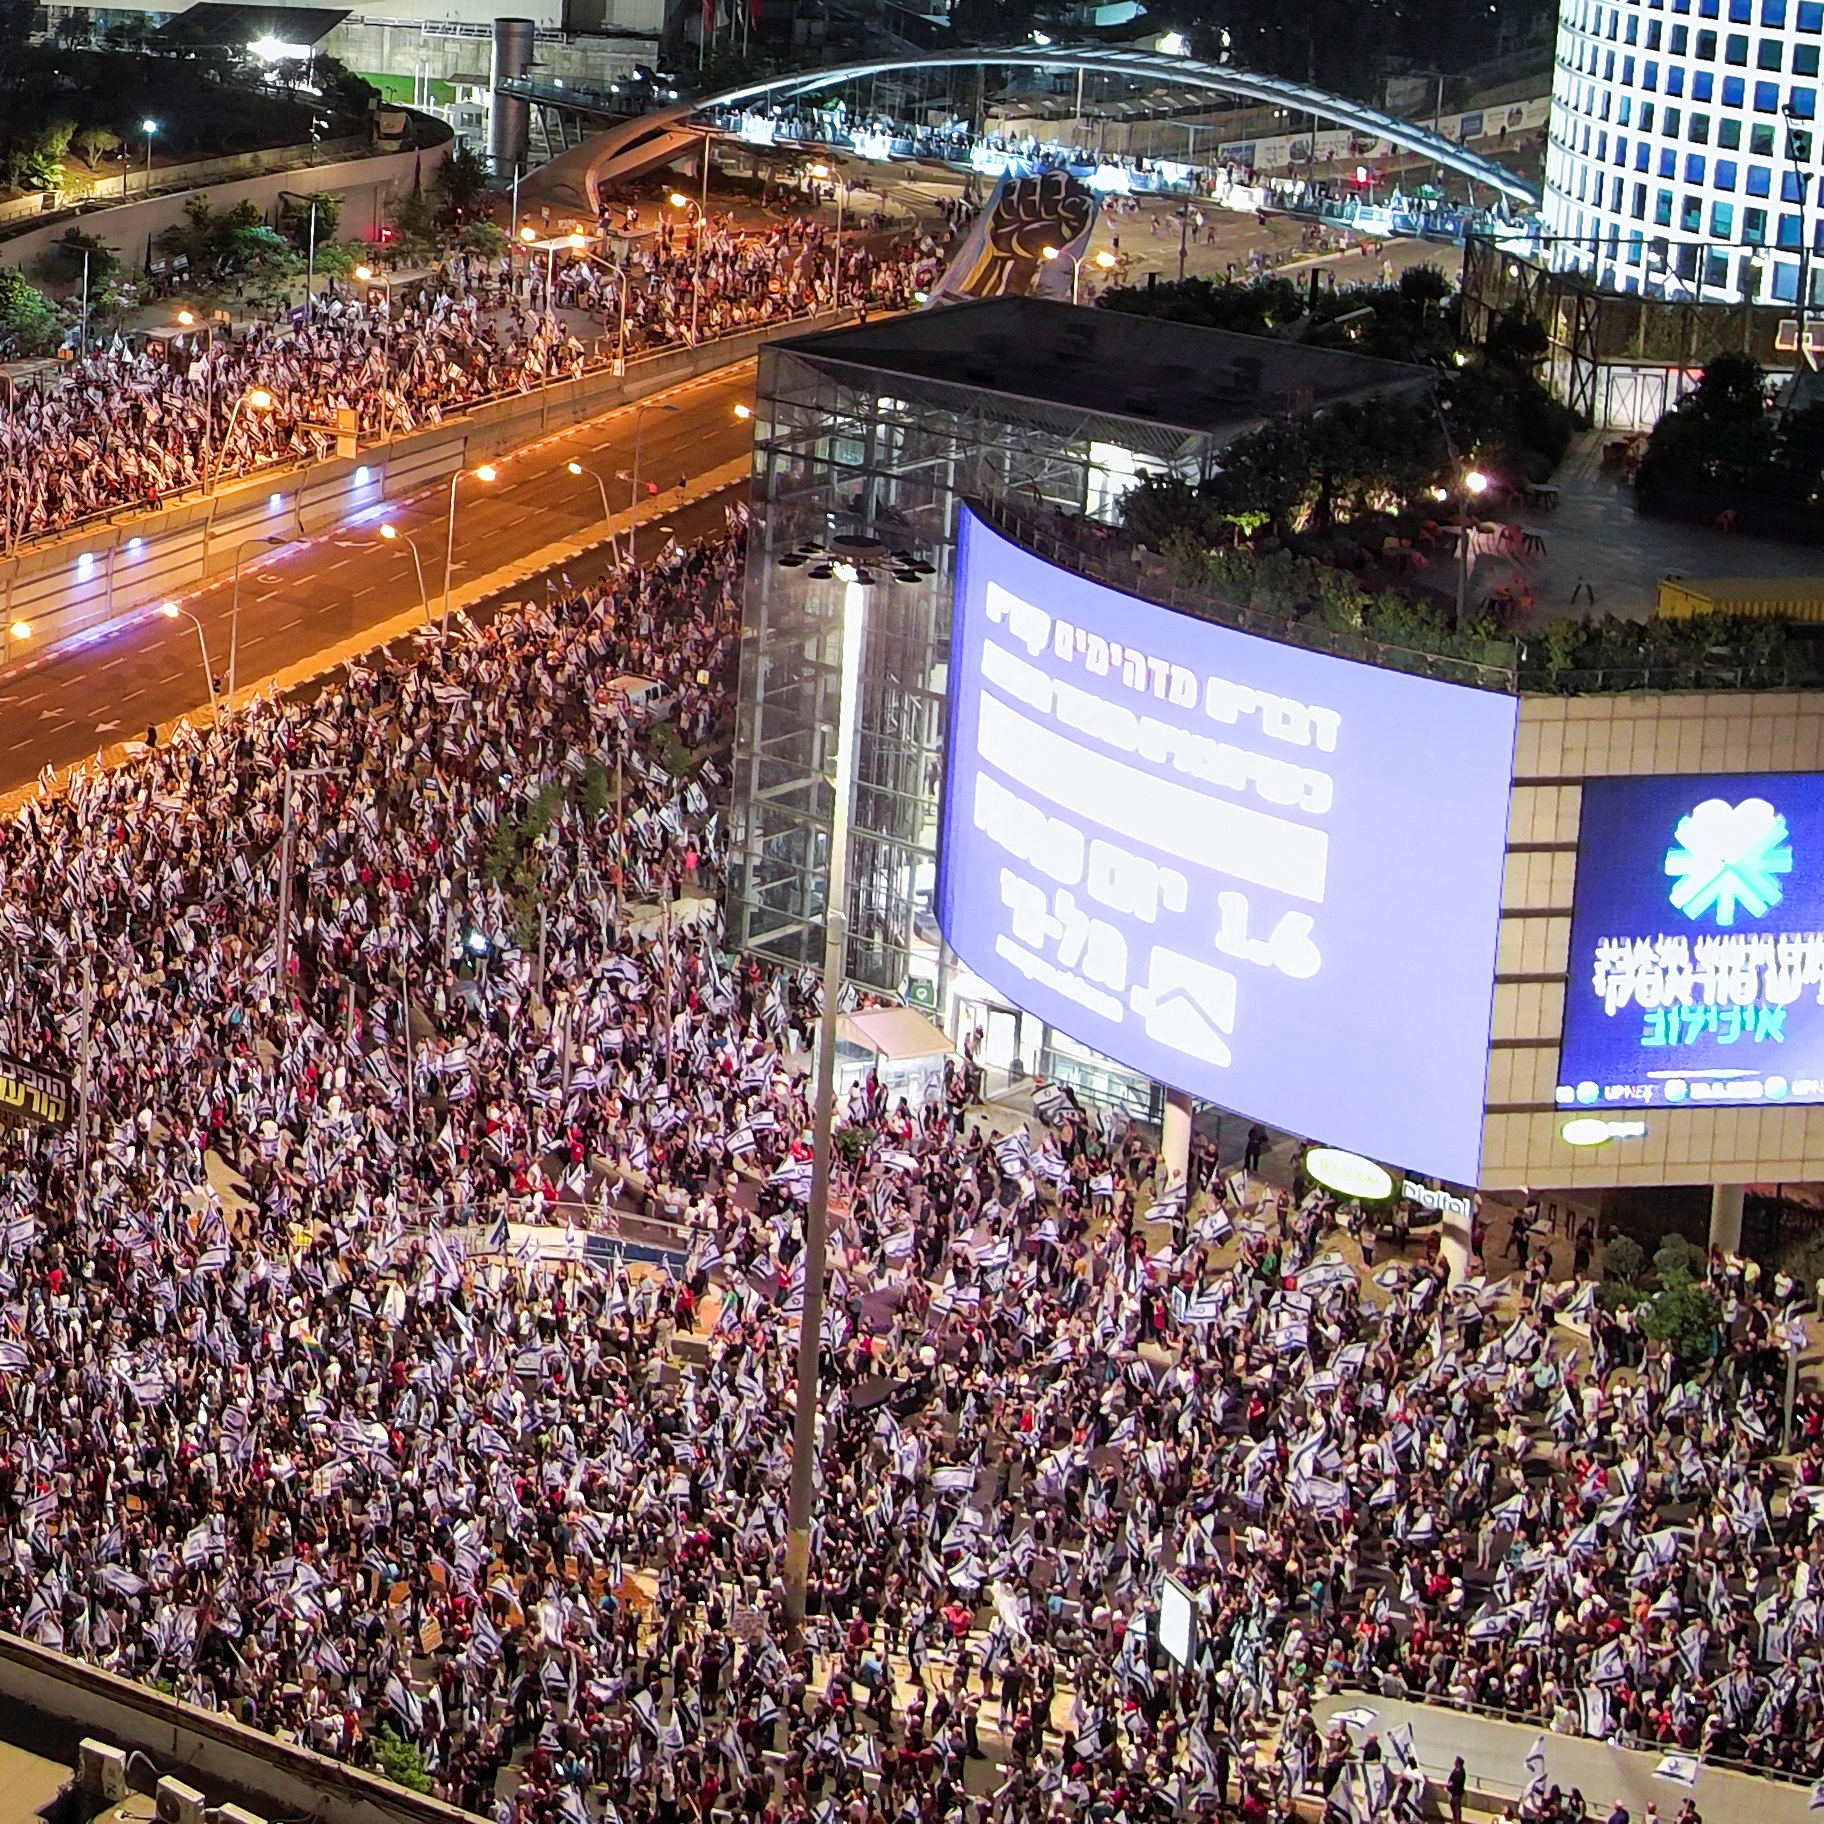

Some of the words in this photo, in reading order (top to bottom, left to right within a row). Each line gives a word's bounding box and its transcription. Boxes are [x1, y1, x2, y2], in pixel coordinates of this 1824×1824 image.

[1054, 620, 1198, 709] מדהימים
[1216, 892, 1321, 978] 1.6
[1641, 1004, 1787, 1046] איכילוב
[1402, 1179, 1470, 1217] Digital
